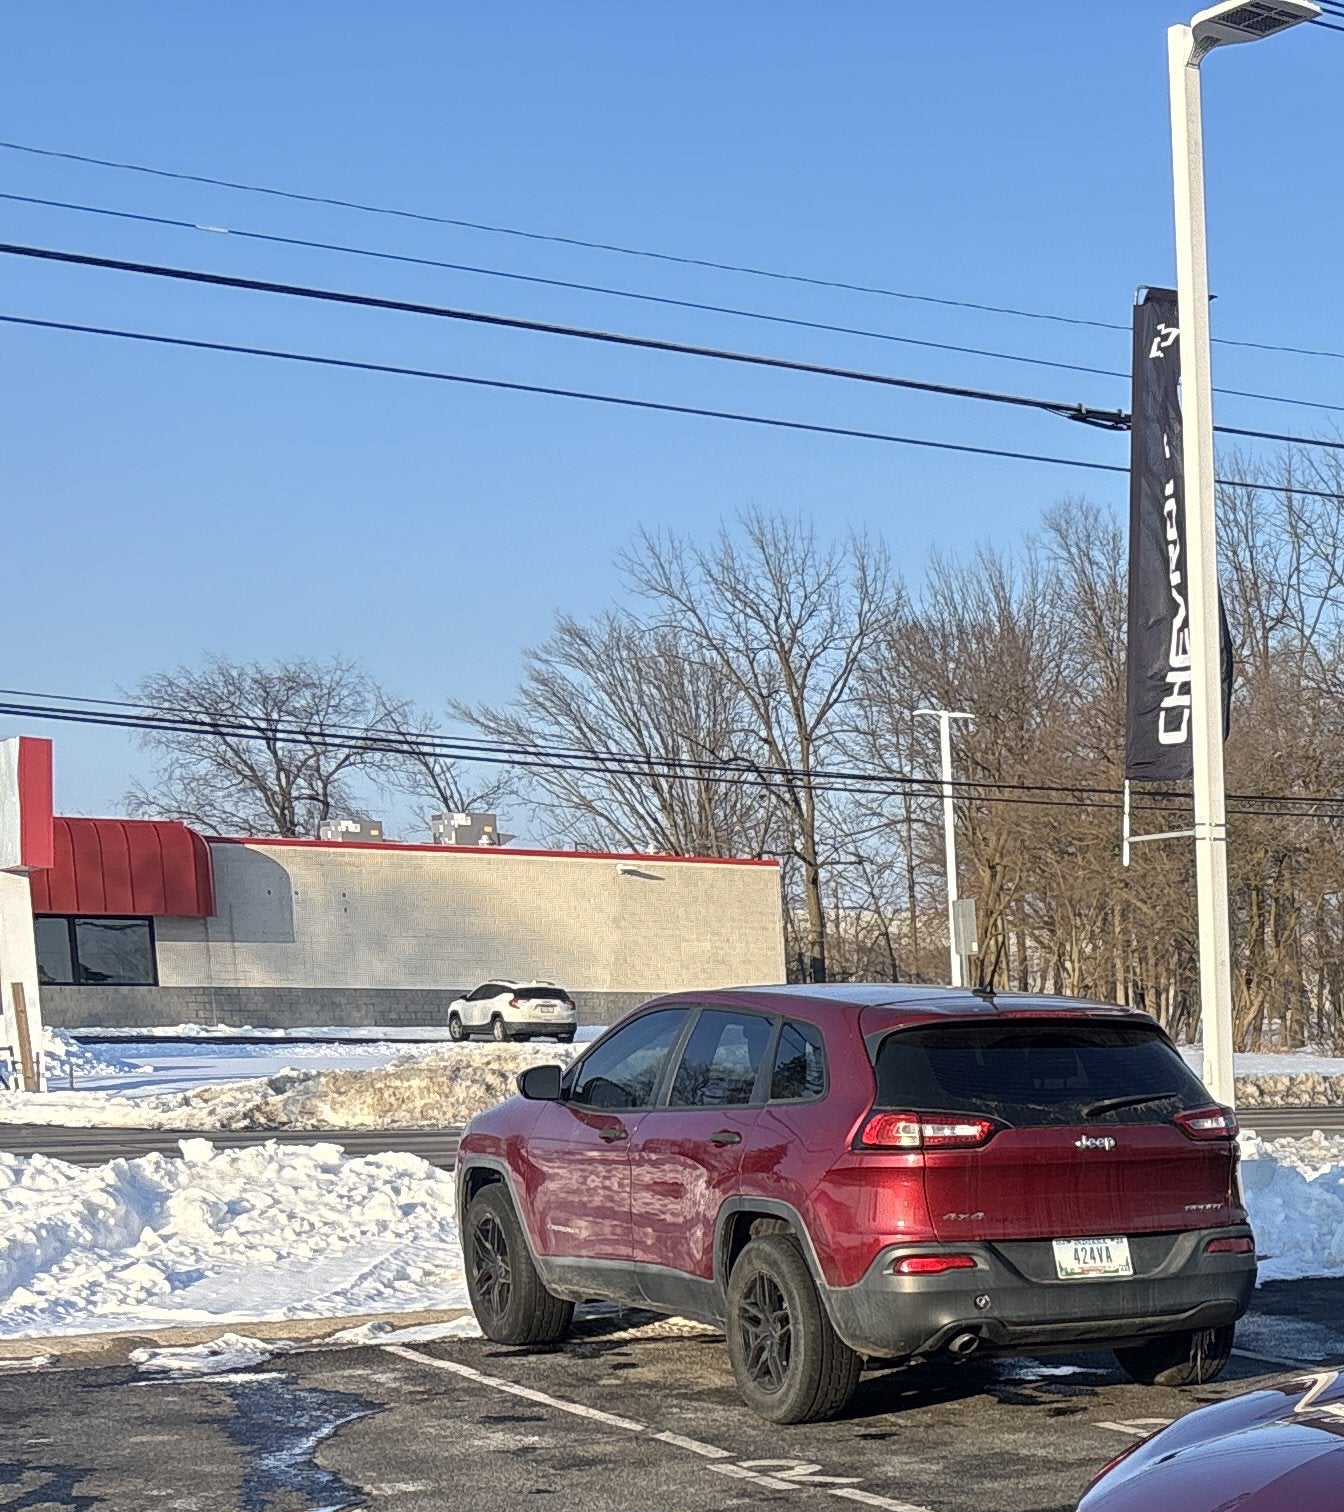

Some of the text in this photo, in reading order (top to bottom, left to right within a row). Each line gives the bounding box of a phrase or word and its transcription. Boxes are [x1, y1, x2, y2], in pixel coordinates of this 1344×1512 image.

[1159, 430, 1192, 744] CHEVRO
[1074, 1134, 1116, 1151] Jeep
[1073, 1246, 1113, 1265] 424VA
